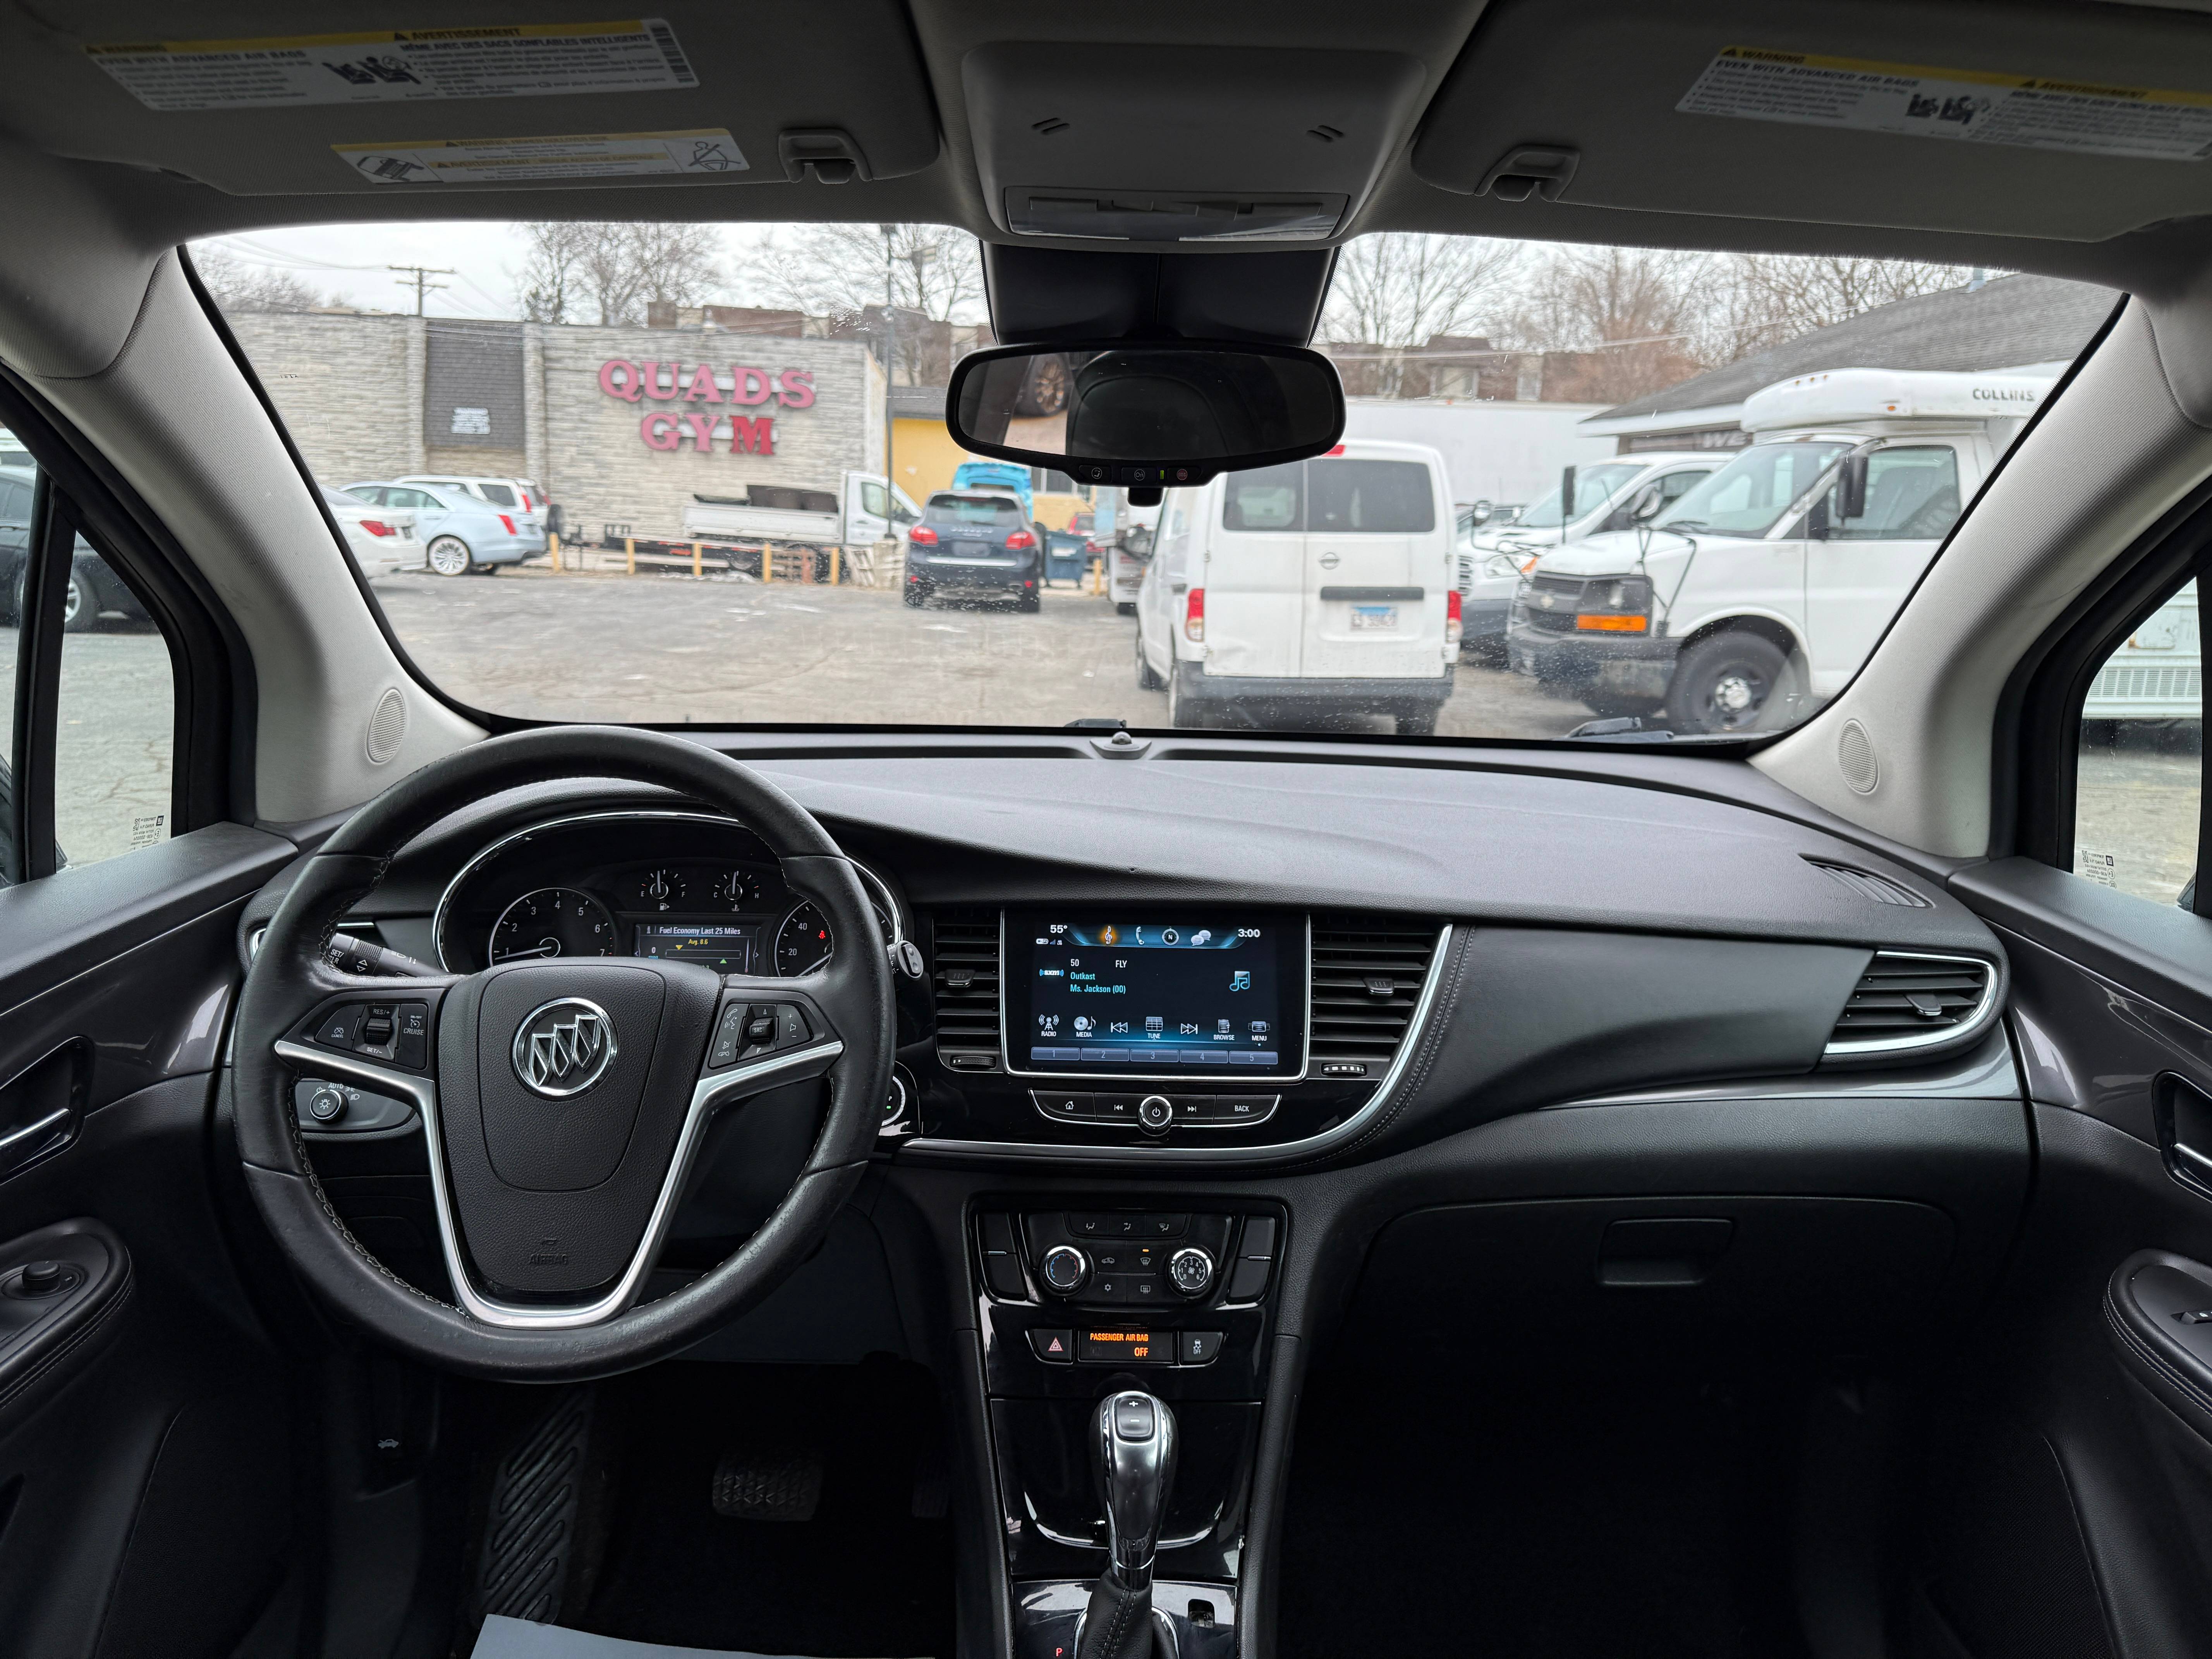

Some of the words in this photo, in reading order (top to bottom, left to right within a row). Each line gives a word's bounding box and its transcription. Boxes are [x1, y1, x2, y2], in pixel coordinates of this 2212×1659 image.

[412, 28, 520, 40] AVERTISSEMENT
[434, 41, 460, 50] AVEC
[462, 40, 483, 49] DES
[484, 40, 512, 48] SACS
[245, 51, 267, 61] AIR
[1716, 60, 1749, 70] EVEN
[1752, 63, 1784, 73] WITH
[1788, 67, 1856, 80] ADVANCED
[599, 360, 816, 408] QUADS
[1973, 388, 2035, 402] COLLINS
[641, 412, 775, 455] GYM
[555, 900, 561, 909] 4
[531, 907, 537, 915] 3
[578, 907, 584, 916] 5
[512, 923, 518, 932] 2
[595, 924, 601, 933] 6
[673, 927, 700, 936] Economy
[1238, 929, 1261, 938] 3:00
[330, 948, 344, 958] SET/
[505, 947, 509, 955] 1
[788, 948, 797, 956] 20
[1070, 958, 1080, 967] 50
[1115, 960, 1127, 968] FLY
[1070, 972, 1096, 980] Outkast
[1070, 984, 1082, 993] Ms.
[1084, 984, 1111, 993] Jackson
[1052, 1049, 1055, 1058] 1
[1101, 1051, 1106, 1059] 2
[1200, 1053, 1205, 1061] 4
[1249, 1054, 1254, 1062] 5
[1089, 1333, 1124, 1341] PASSENGER
[1125, 1333, 1135, 1341] AIR
[1136, 1333, 1149, 1342] BAG
[1134, 1347, 1149, 1357] OFF
[1056, 1647, 1063, 1657] P
